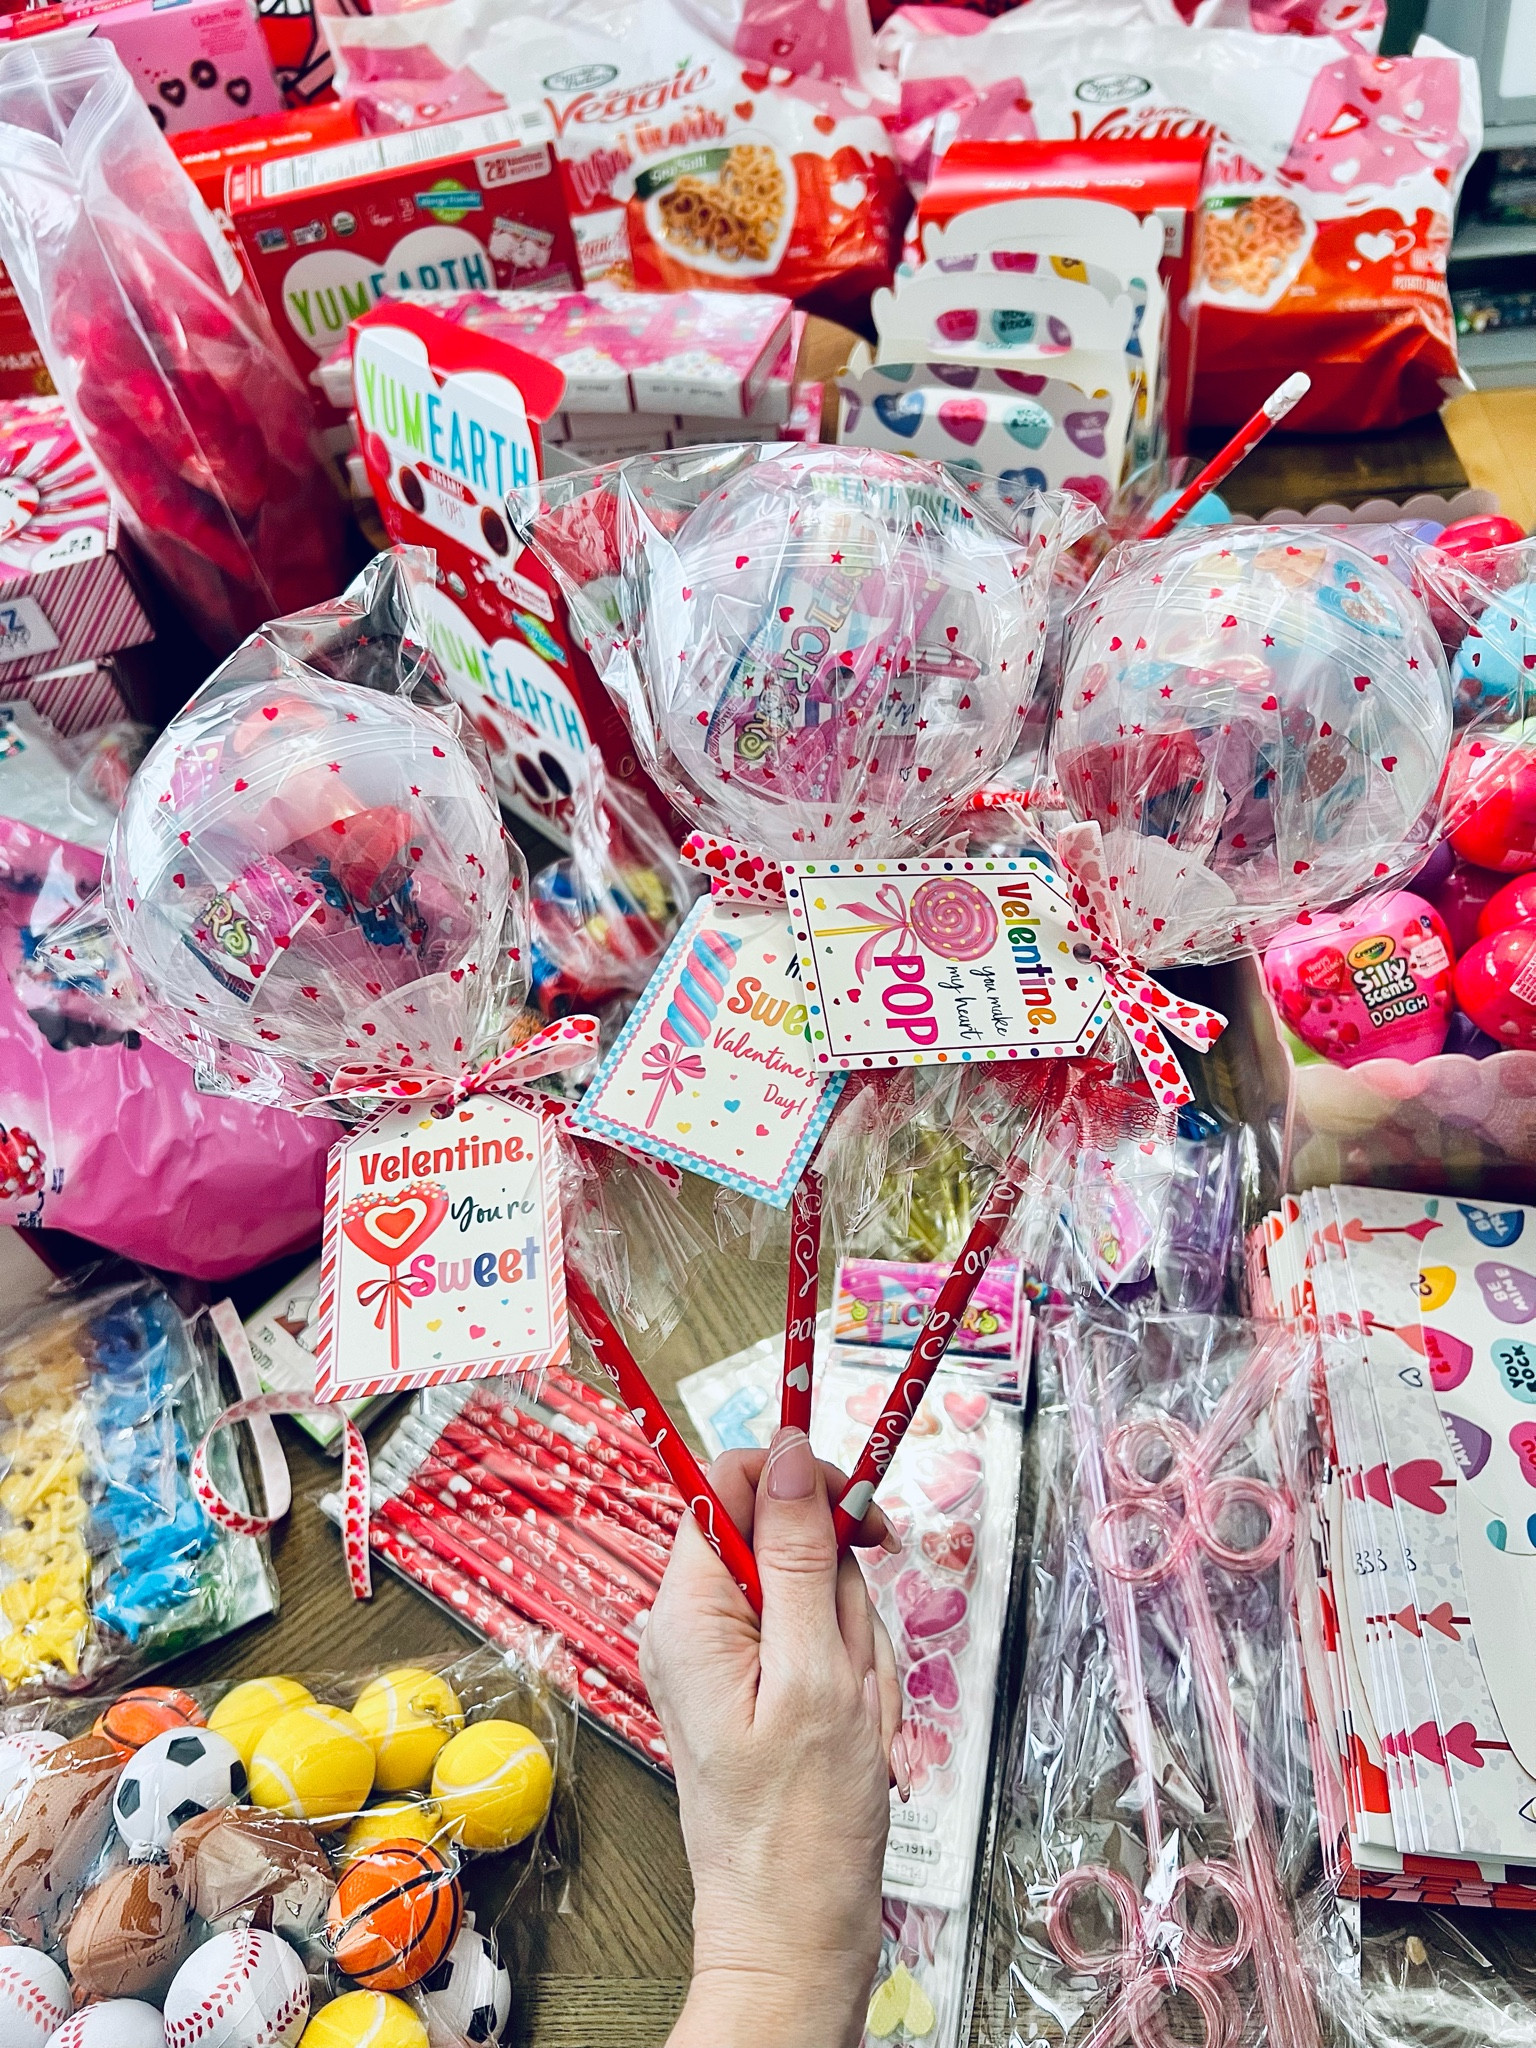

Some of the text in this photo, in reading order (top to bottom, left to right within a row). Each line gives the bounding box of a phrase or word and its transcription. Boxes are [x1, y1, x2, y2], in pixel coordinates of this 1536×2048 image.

[544, 66, 709, 138] Veggie
[362, 357, 528, 504] YUMEARTH
[421, 606, 585, 753] YUMEARTH
[874, 955, 939, 1046] POP
[938, 966, 984, 1041] my heart
[970, 966, 1014, 1037] you make
[1352, 958, 1408, 994] Silly
[1364, 977, 1415, 1008] scents
[727, 976, 813, 1043] Swe
[1369, 995, 1429, 1028] DOUGH
[763, 1083, 808, 1120] Day!
[408, 1236, 541, 1298] Sweet
[1486, 1280, 1509, 1302] BE
[1494, 1267, 1529, 1311] MINE
[1499, 1352, 1525, 1389] YOU
